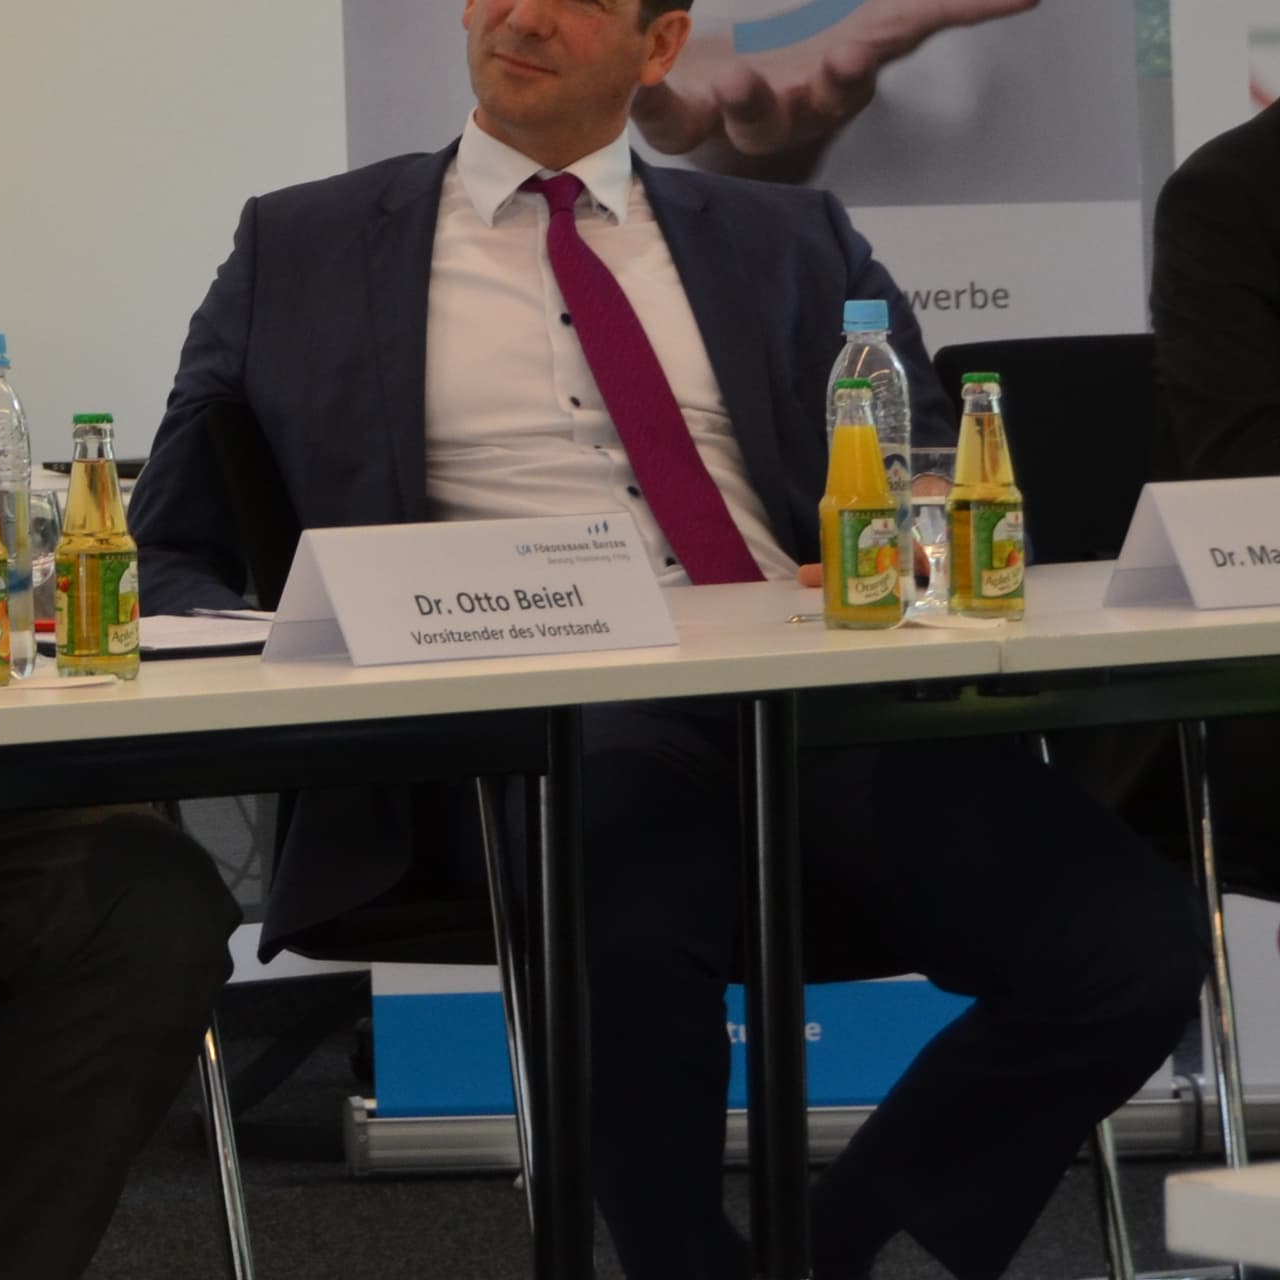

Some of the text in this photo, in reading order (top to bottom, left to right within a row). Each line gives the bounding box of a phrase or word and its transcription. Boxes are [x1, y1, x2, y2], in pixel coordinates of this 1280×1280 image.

[1209, 546, 1245, 568] Dr.
[413, 584, 584, 617] Dr. Otto Beierl
[411, 618, 610, 646] Vorsitzender des Vorstands
